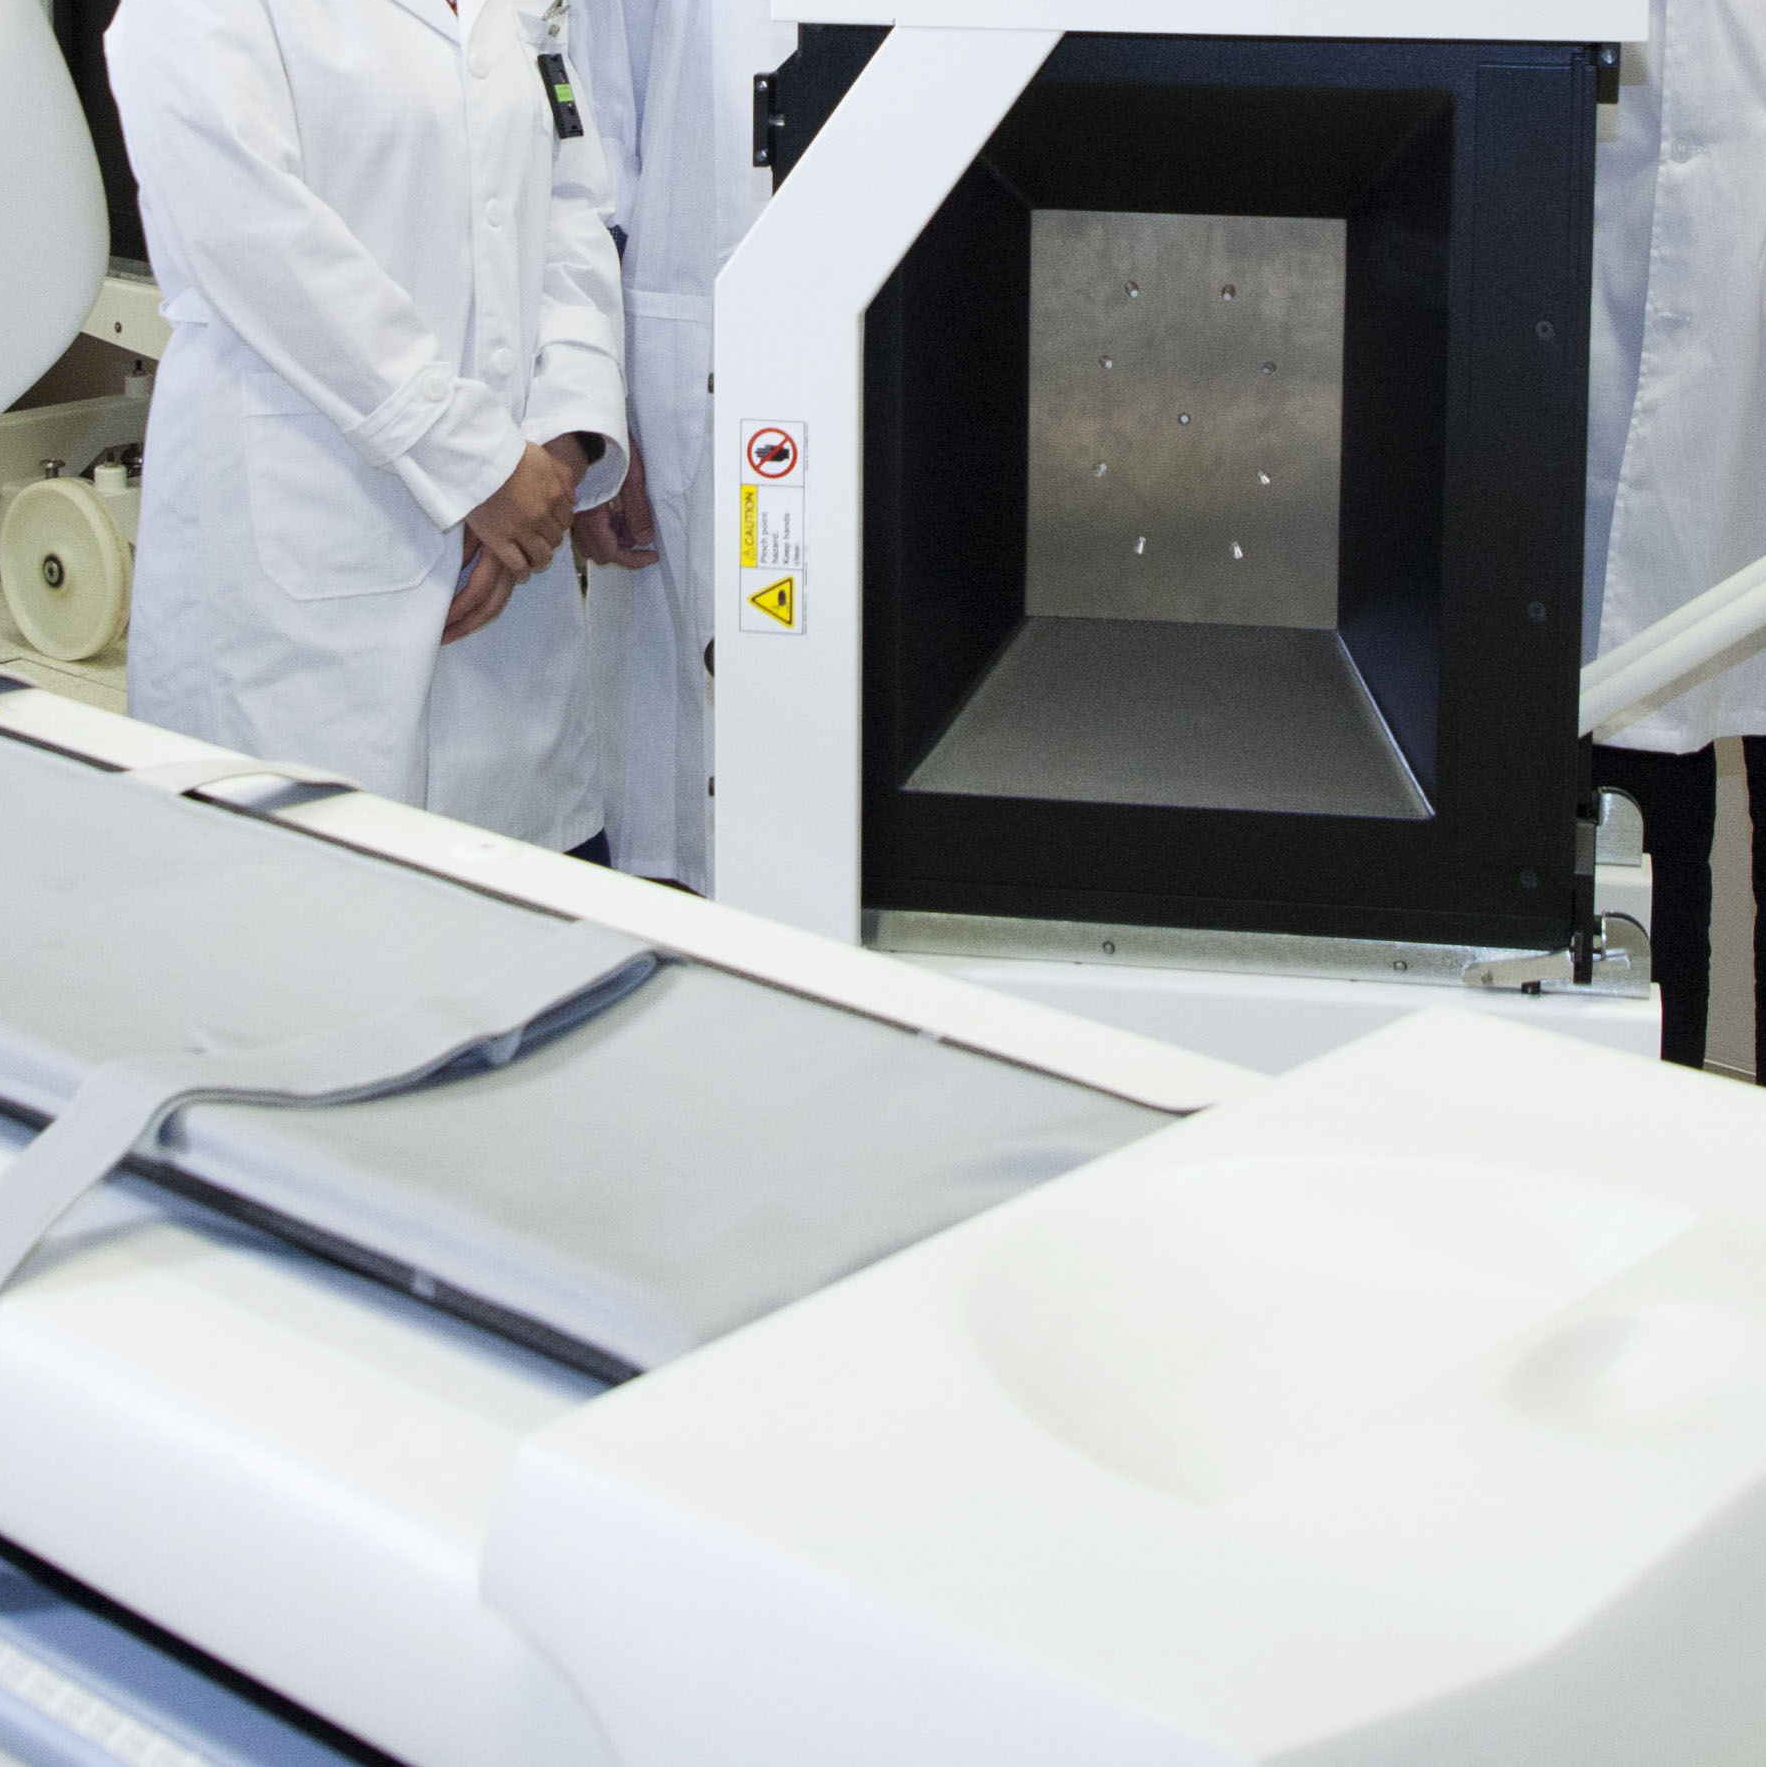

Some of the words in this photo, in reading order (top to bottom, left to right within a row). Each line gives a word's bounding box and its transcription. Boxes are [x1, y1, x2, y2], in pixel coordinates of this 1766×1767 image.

[744, 491, 754, 546] CAUTION
[760, 511, 769, 536] point
[760, 538, 768, 564] Pinch
[783, 542, 791, 565] Keep
